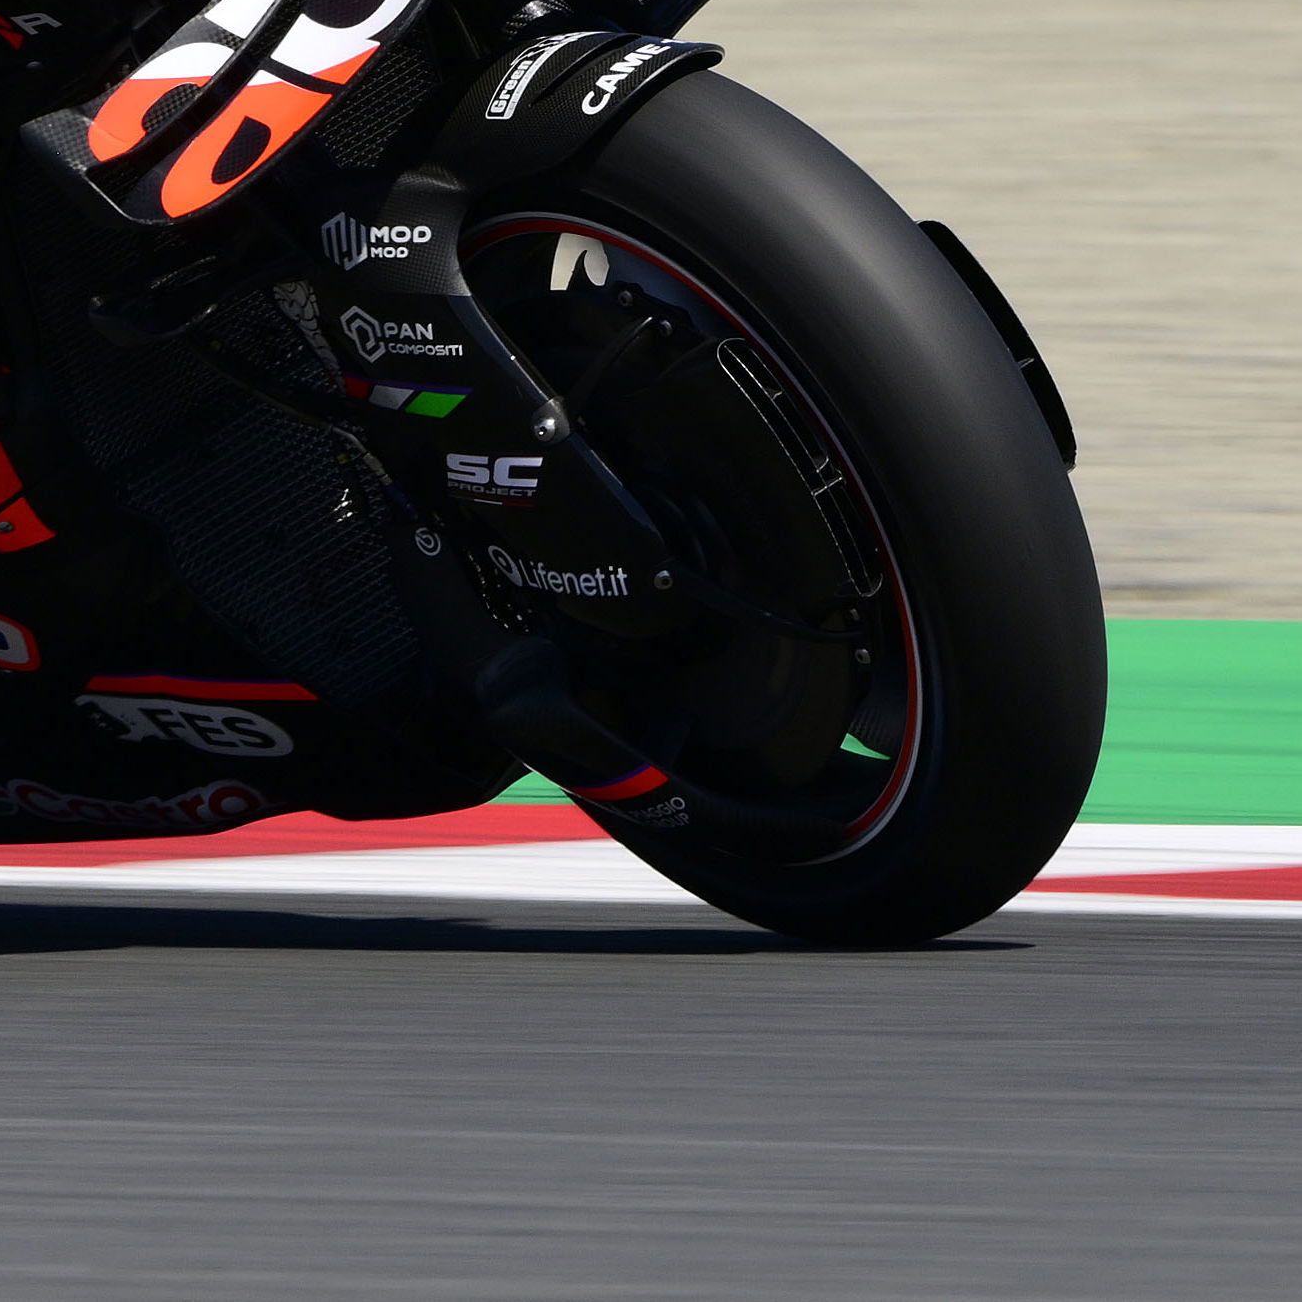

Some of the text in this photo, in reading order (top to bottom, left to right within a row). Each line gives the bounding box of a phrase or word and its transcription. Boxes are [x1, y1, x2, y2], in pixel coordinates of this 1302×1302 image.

[490, 59, 533, 114] Green
[581, 42, 666, 115] CAME
[369, 225, 433, 244] MOD
[370, 247, 409, 259] MOD
[383, 321, 434, 341] PAN
[387, 342, 464, 358] COMPOSITI
[446, 452, 545, 488] SC
[447, 481, 539, 498] PROJECT
[518, 558, 629, 597] Lifenet.it
